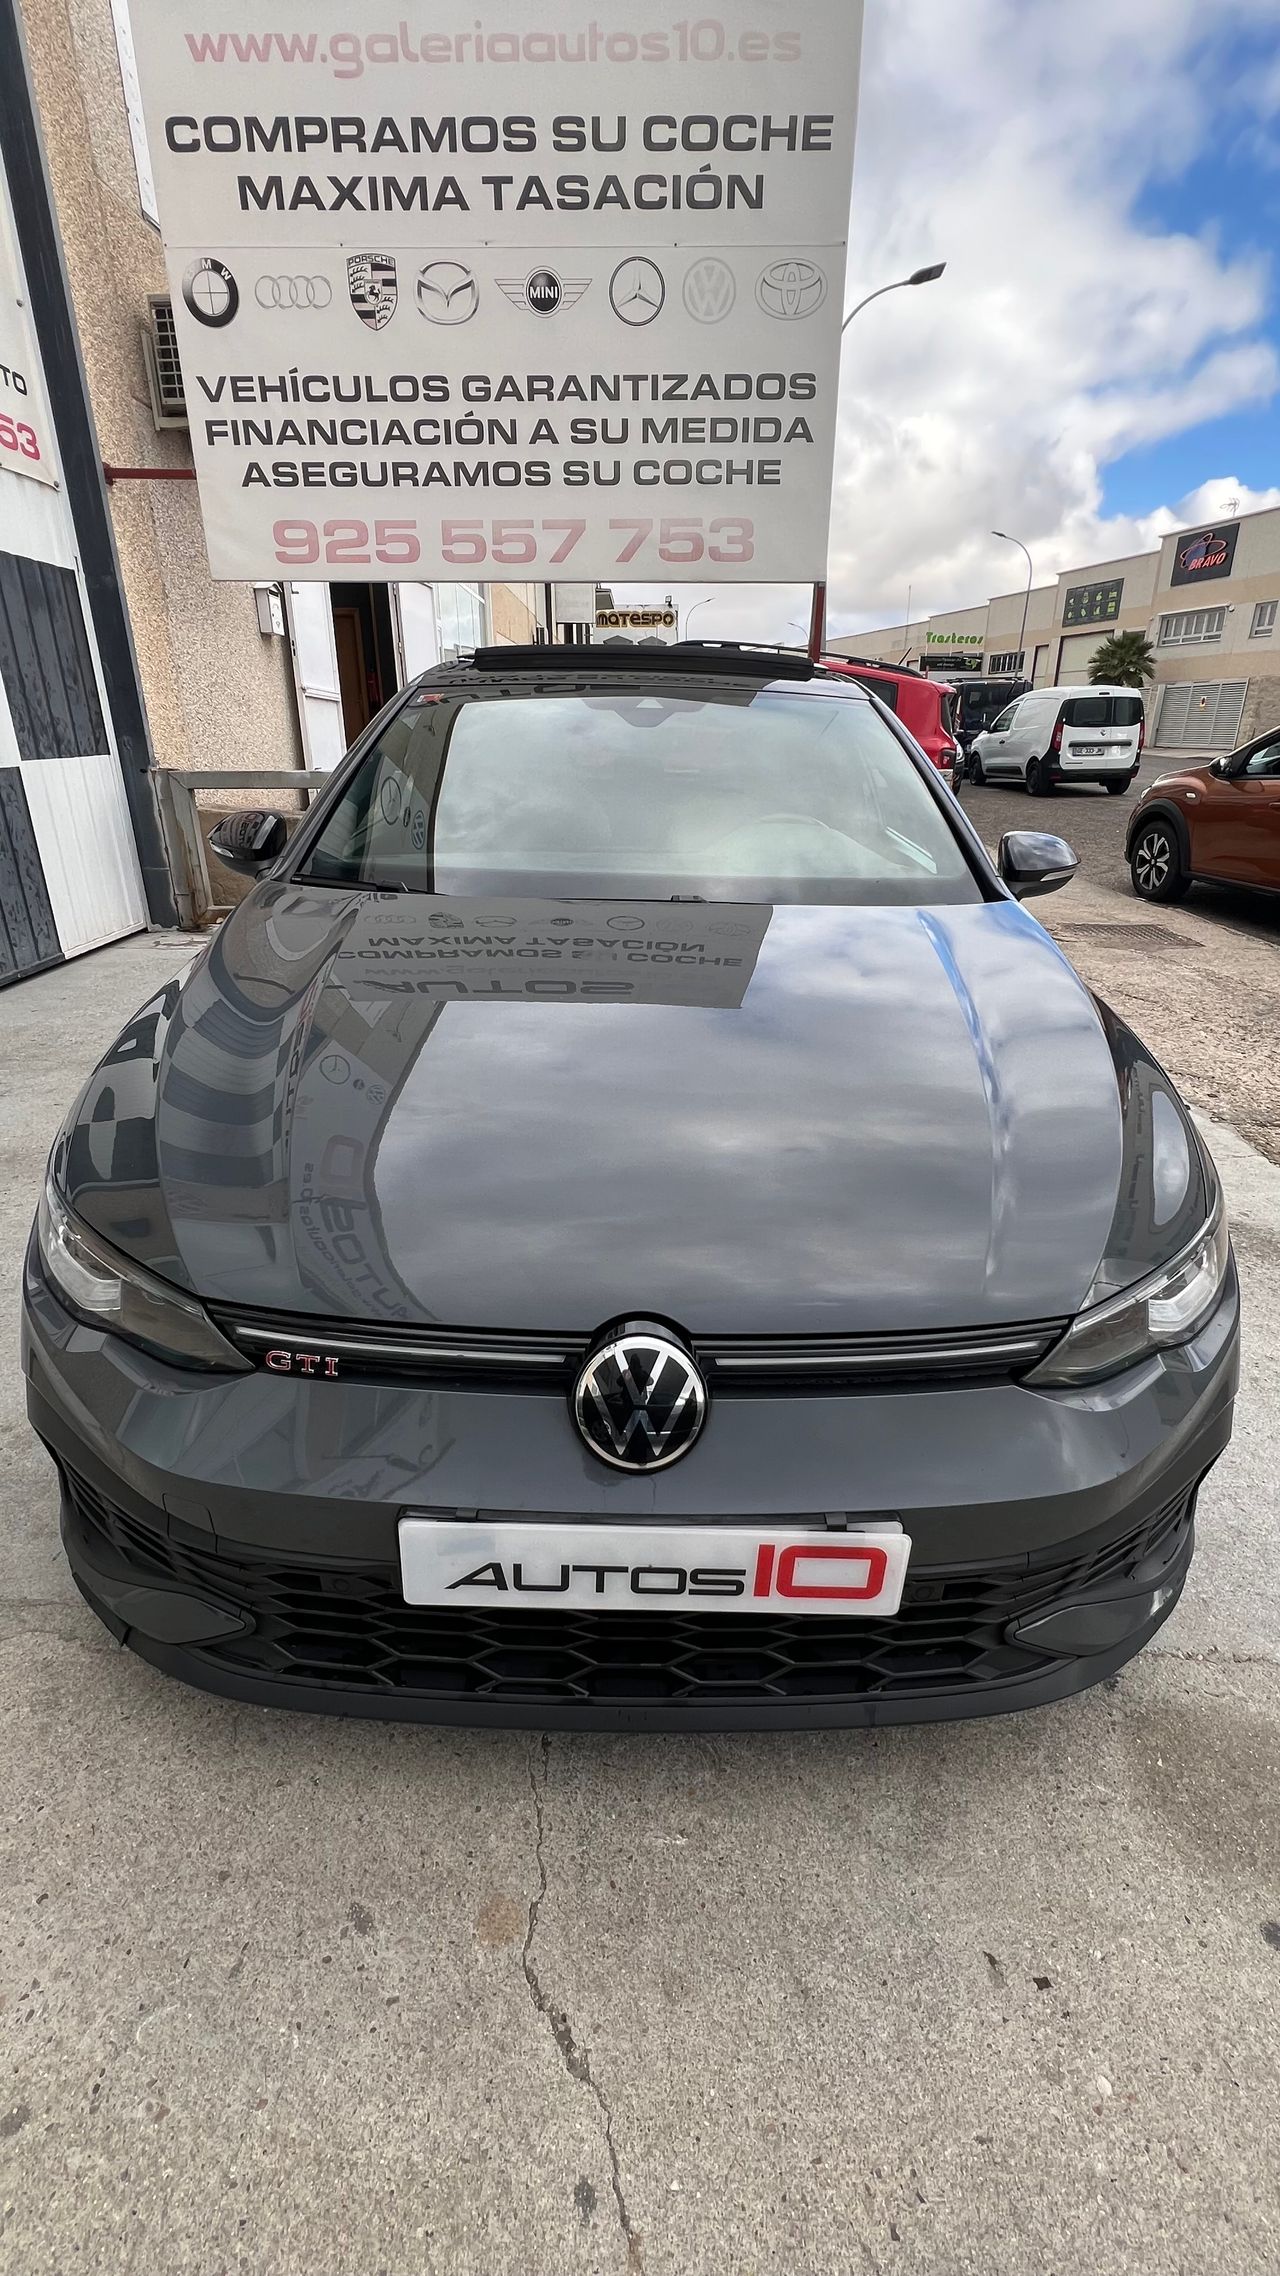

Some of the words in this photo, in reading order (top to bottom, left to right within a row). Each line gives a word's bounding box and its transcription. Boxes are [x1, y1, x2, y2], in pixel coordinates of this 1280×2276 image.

[184, 19, 801, 80] www.galeriaautos10.es
[165, 116, 538, 154] COMPRAMOS
[553, 116, 628, 154] SU
[643, 115, 835, 153] COCHE
[238, 176, 471, 213] MAXIMA
[482, 164, 765, 212] TASACIÓN
[529, 286, 559, 300] MINI
[197, 368, 451, 404] VEHÍCULOS
[462, 373, 818, 404] GARANTIZADOS
[205, 411, 519, 447] FINANCIACIÓN
[529, 419, 561, 446] A
[571, 418, 630, 446] SU
[643, 417, 815, 445] MEDIDA
[242, 461, 552, 489] ASEGURAMOS
[564, 461, 622, 488] SU
[634, 460, 783, 487] COCHE
[272, 518, 424, 568] 925
[441, 518, 588, 567] 557
[612, 518, 755, 566] 753
[1188, 552, 1227, 571] BRAVO
[926, 631, 984, 645] Trasteros
[265, 1350, 340, 1377] GTI
